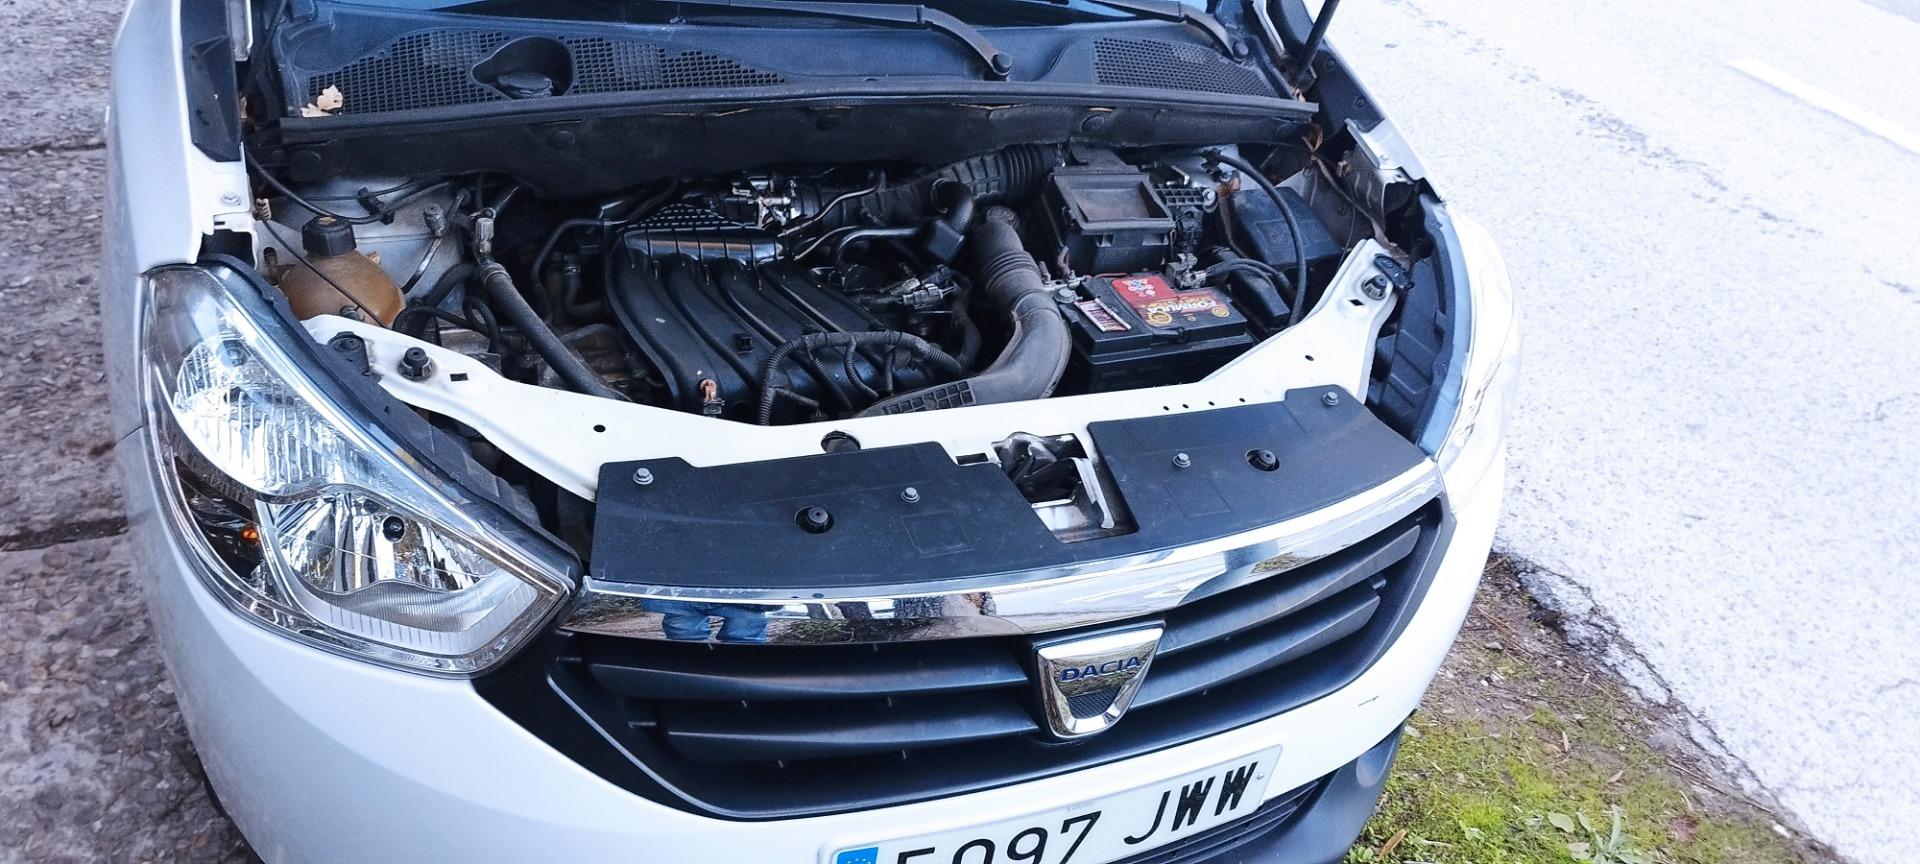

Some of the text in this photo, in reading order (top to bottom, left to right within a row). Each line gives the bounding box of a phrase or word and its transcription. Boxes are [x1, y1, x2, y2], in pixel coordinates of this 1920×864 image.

[1147, 300, 1217, 313] FORMULA
[1060, 656, 1140, 681] DACIA
[1123, 761, 1258, 845] JWW
